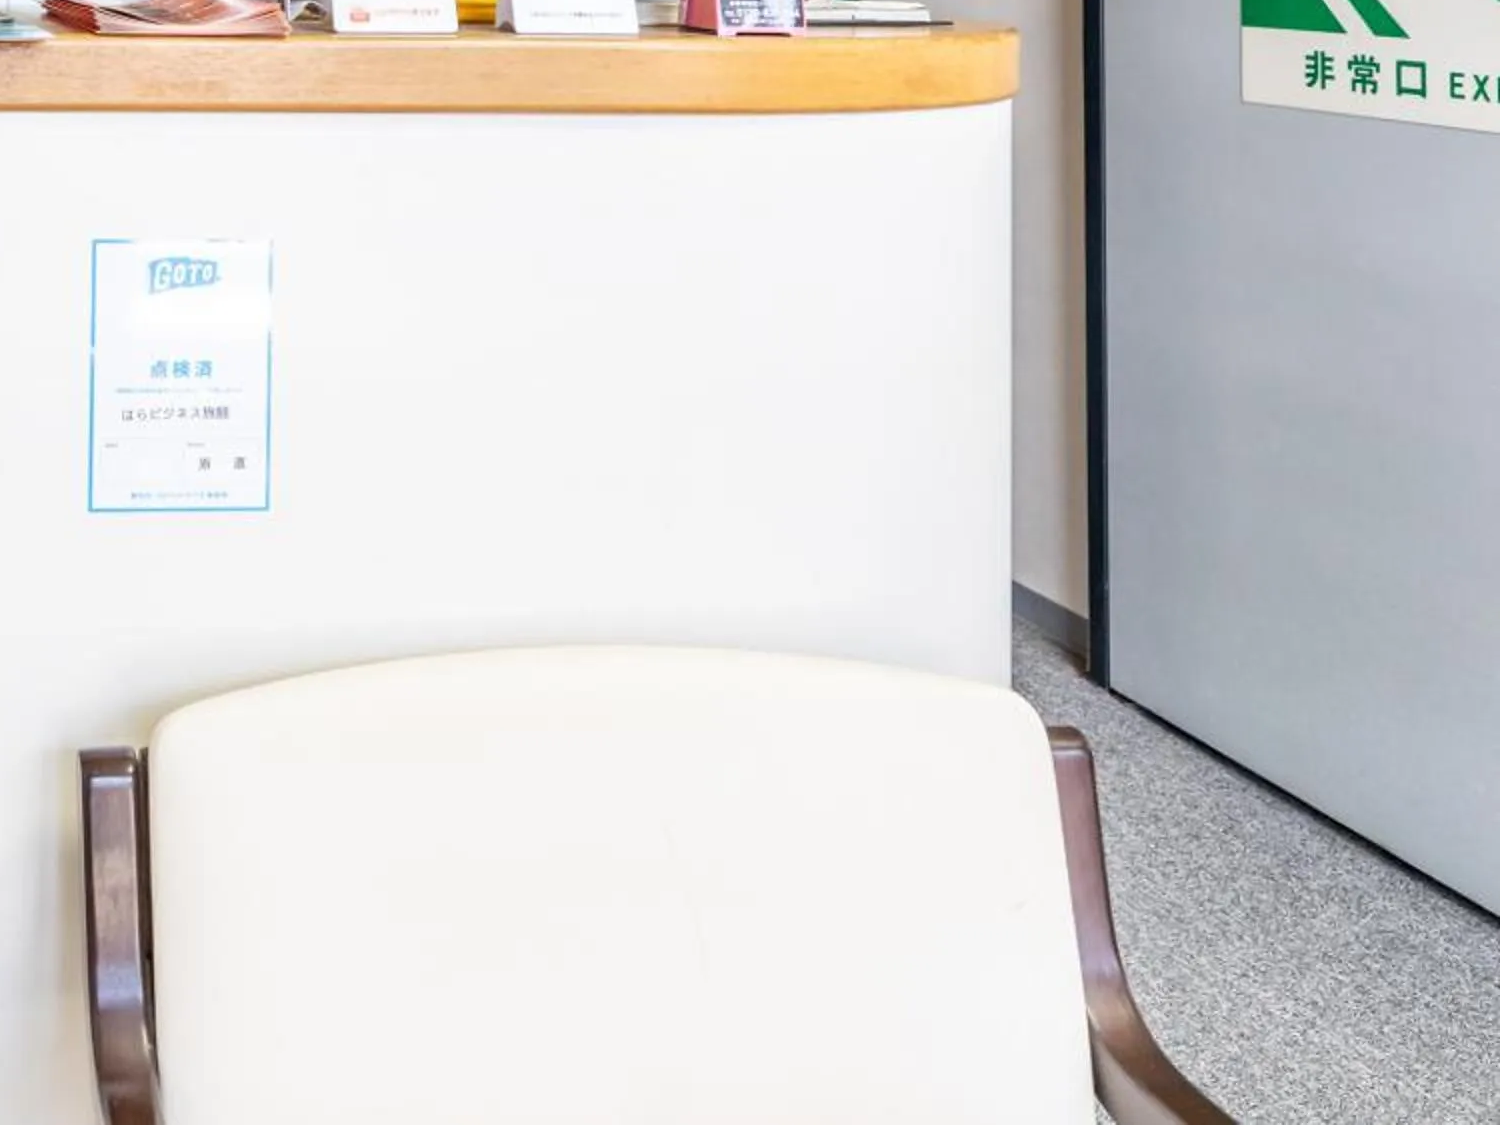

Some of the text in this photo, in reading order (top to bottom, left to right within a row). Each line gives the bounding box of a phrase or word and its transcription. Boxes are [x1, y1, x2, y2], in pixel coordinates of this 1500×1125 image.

[1305, 50, 1427, 98] 非常口
[150, 360, 213, 379] 点検済
